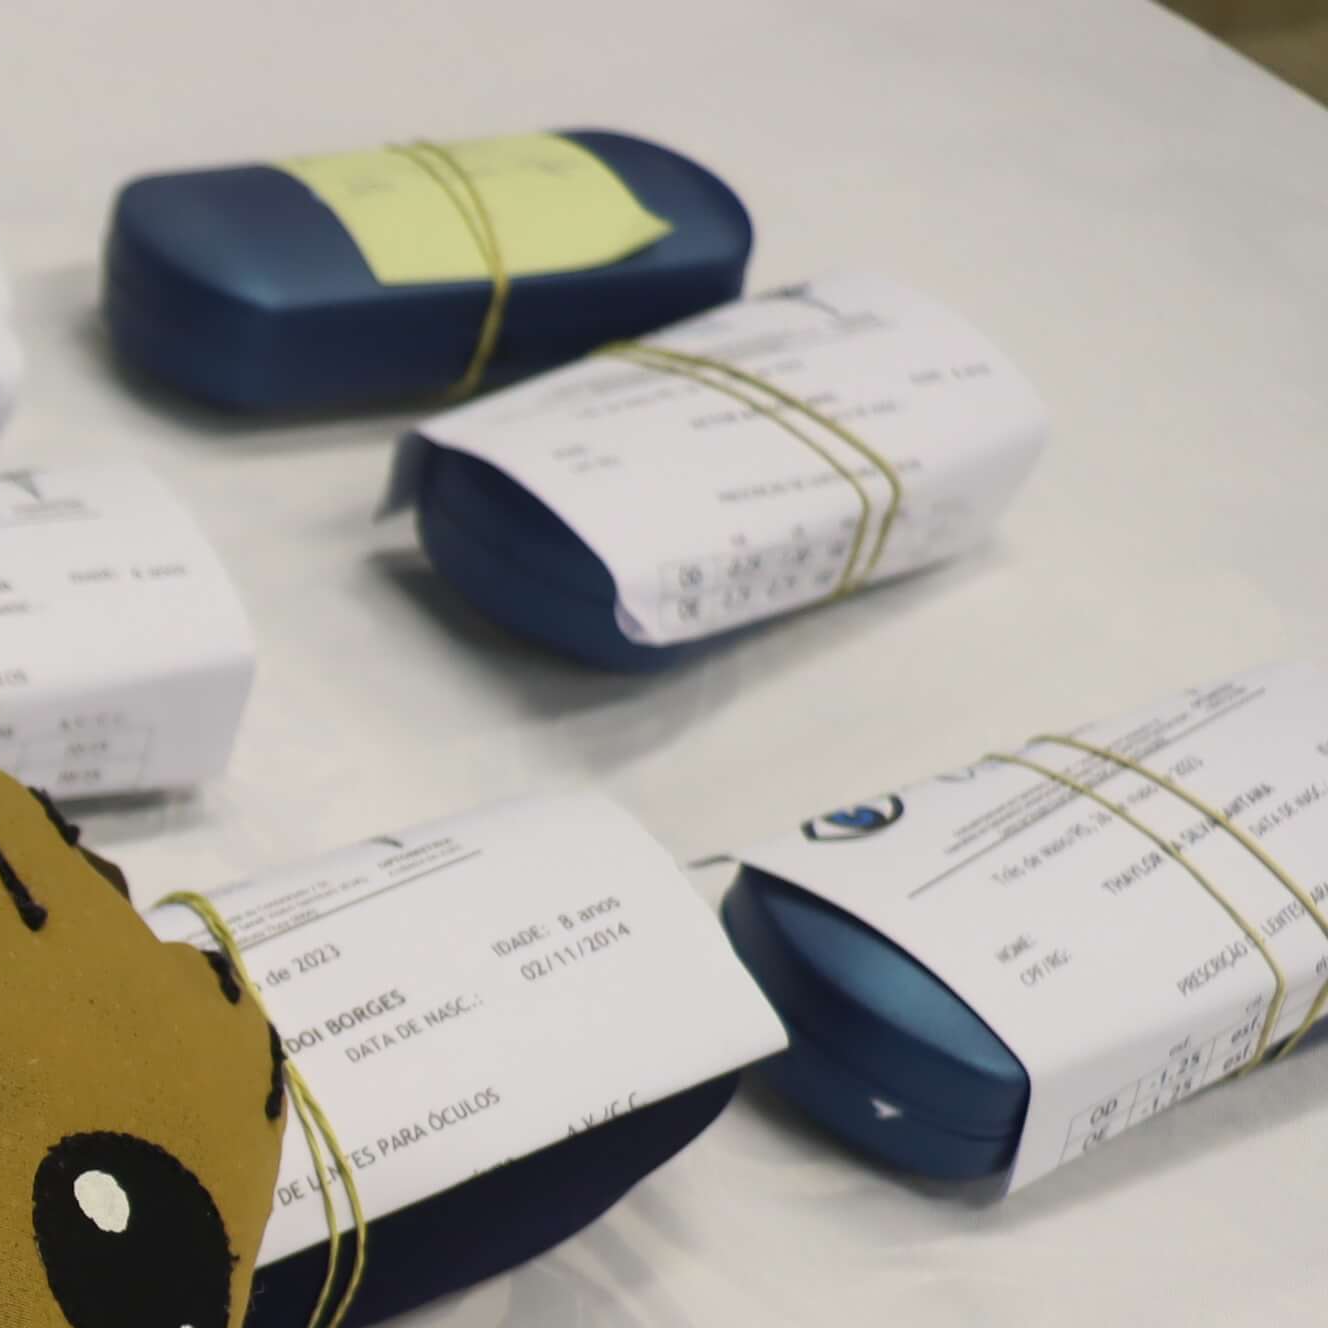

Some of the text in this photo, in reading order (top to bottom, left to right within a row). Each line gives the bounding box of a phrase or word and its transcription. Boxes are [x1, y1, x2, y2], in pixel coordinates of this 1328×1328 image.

[491, 896, 621, 958] IDADE: 8 anos
[520, 921, 631, 981] 02/11/2014
[266, 944, 341, 986] de 2023
[328, 989, 407, 1037] BORGES
[345, 1034, 396, 1064] DATA
[396, 1017, 423, 1039] DE
[278, 1183, 304, 1208] DE
[378, 1124, 427, 1157] PARA
[428, 1087, 501, 1131] ÓCULOS
